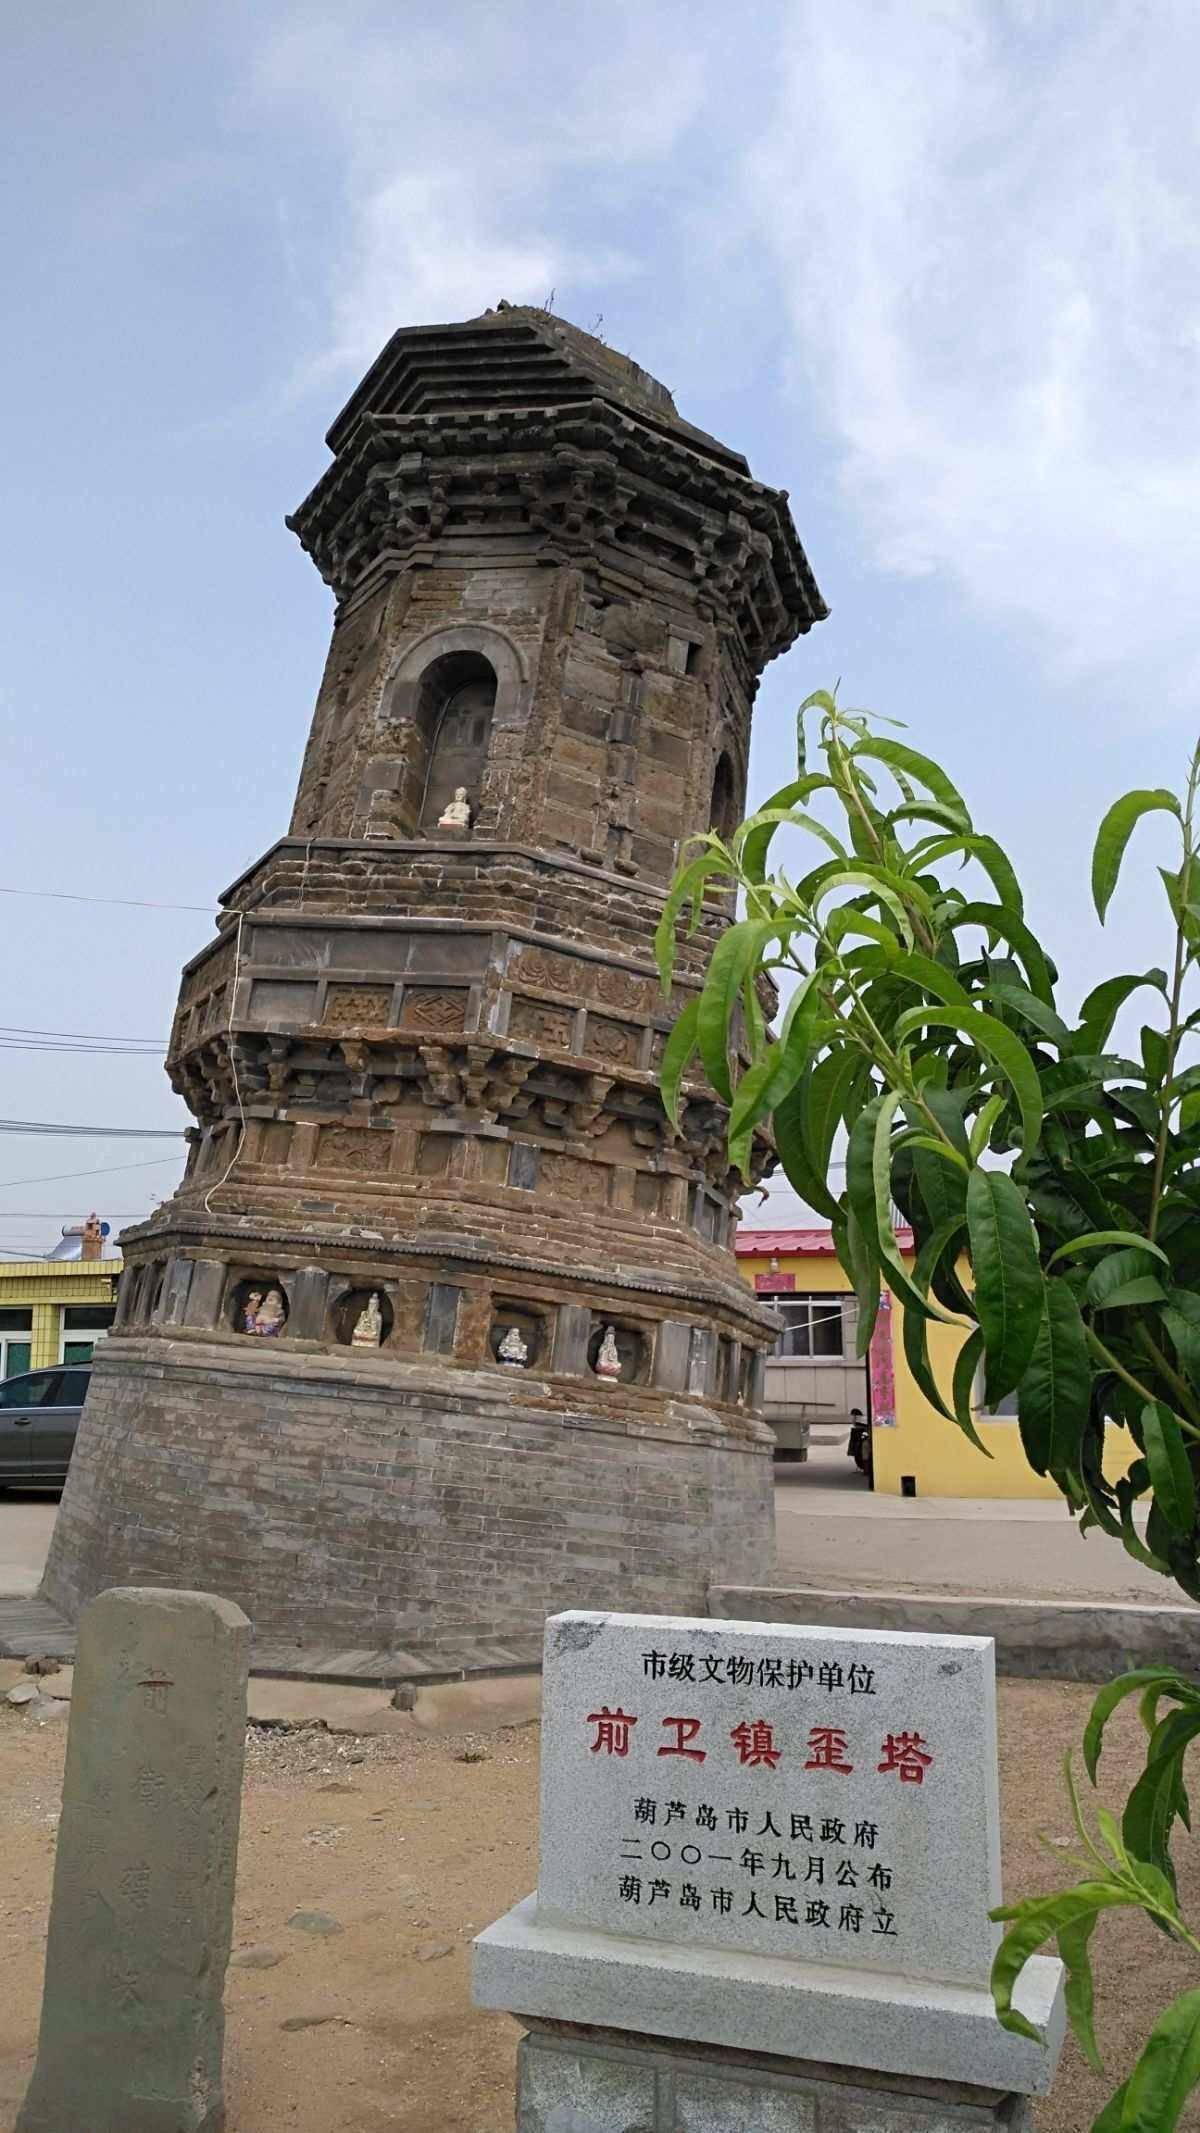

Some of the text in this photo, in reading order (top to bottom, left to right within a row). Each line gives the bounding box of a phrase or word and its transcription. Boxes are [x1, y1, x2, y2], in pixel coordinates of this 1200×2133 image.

[642, 1650, 876, 1694] 市级文物保护单位
[587, 1706, 933, 1784] 前卫镇歪塔
[634, 1797, 879, 1849] 葫芦岛市人民政府
[619, 1875, 898, 1936] 葫芦岛市人民政府立
